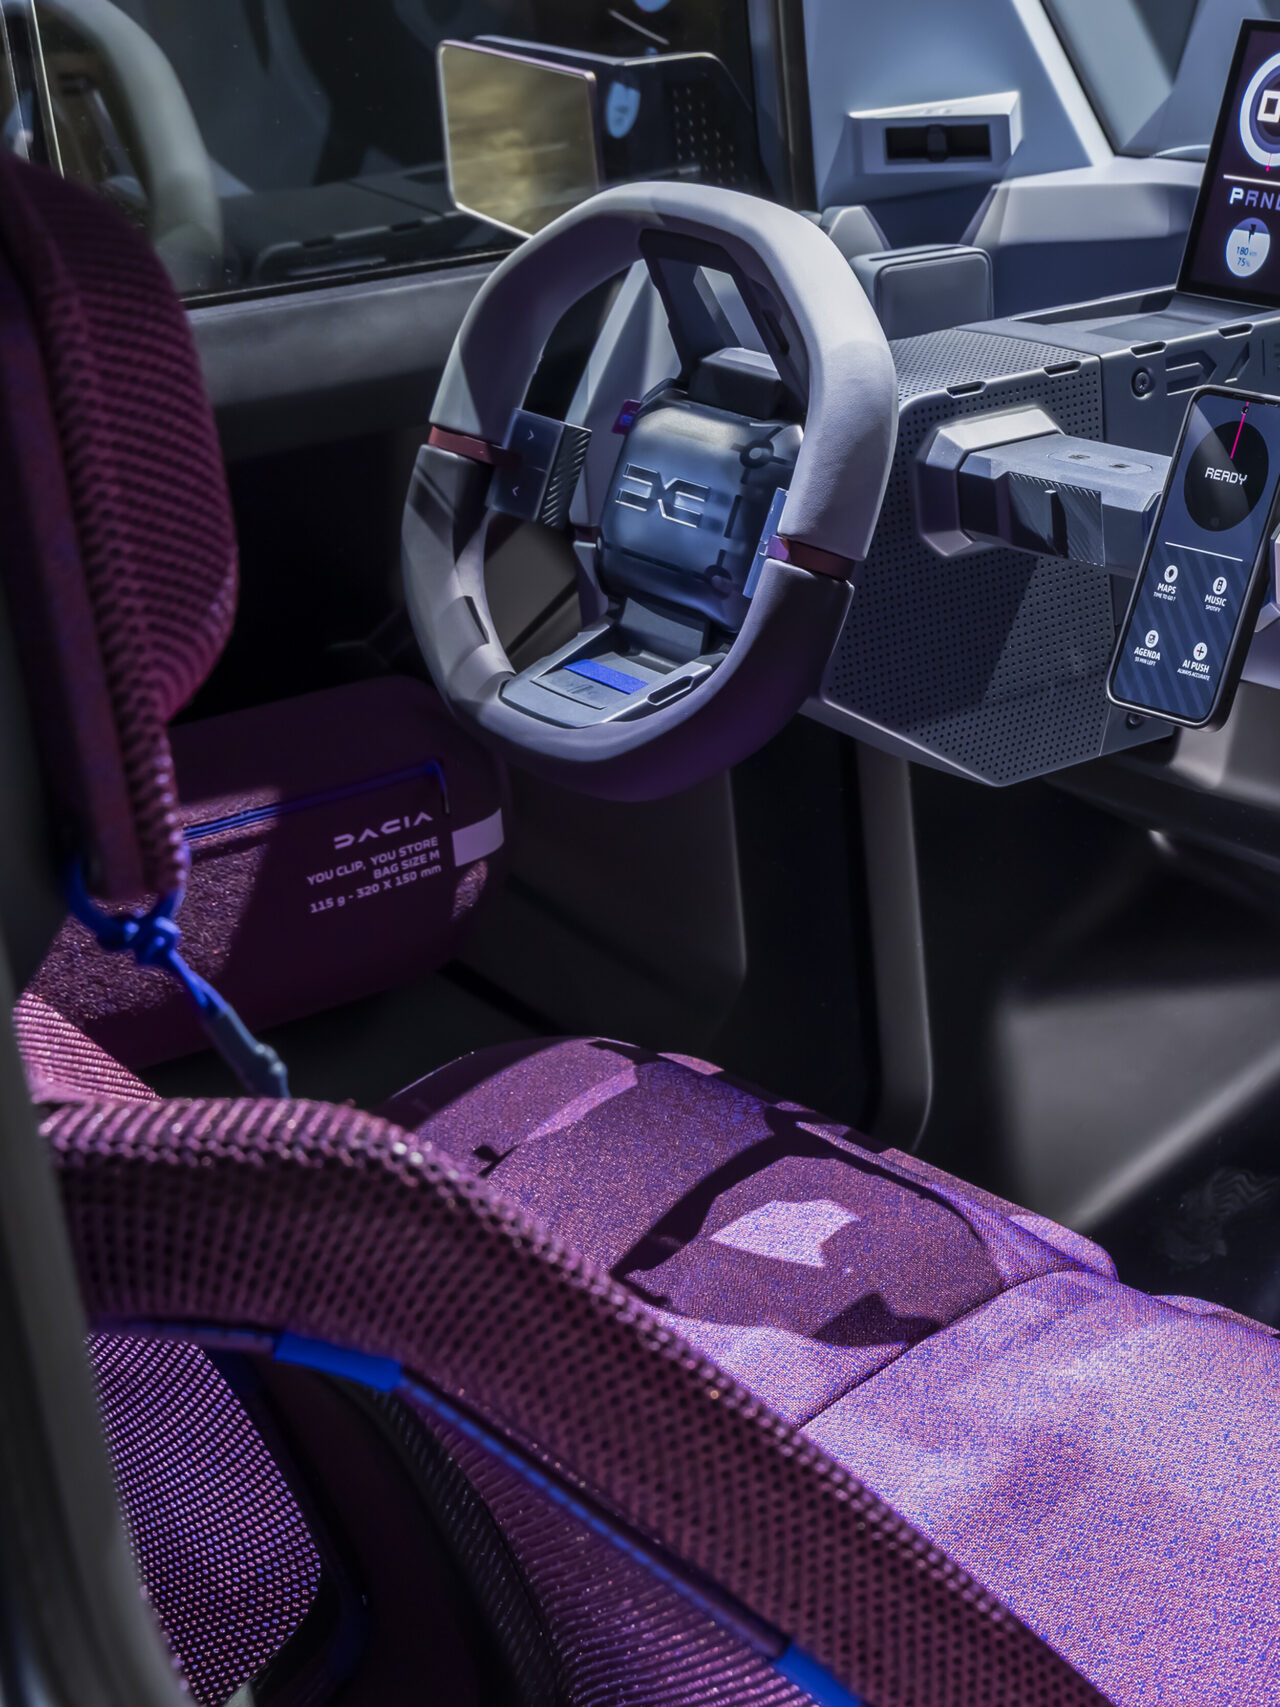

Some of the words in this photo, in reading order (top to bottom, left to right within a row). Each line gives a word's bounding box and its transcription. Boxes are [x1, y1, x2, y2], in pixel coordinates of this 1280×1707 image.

[1204, 466, 1248, 486] READY
[1157, 583, 1177, 595] MAPS
[1204, 594, 1227, 607] MUSIC
[1205, 604, 1222, 613] SPOTIFY
[1133, 646, 1161, 661] AGENDA
[1182, 659, 1191, 669] AI
[1191, 661, 1210, 674] PUSH
[1191, 670, 1211, 681] ACCURATE
[333, 811, 433, 850] DACIA
[306, 869, 334, 885] YOU
[335, 860, 366, 877] CLIP,
[370, 849, 396, 865] YOU
[398, 836, 439, 857] STORE
[373, 862, 399, 879] BAG
[400, 853, 427, 870] SIZE
[429, 849, 441, 860] M
[311, 897, 334, 913] 115
[337, 896, 346, 907] g
[356, 883, 380, 898] 320
[395, 871, 418, 886] 150
[420, 865, 442, 878] mm
